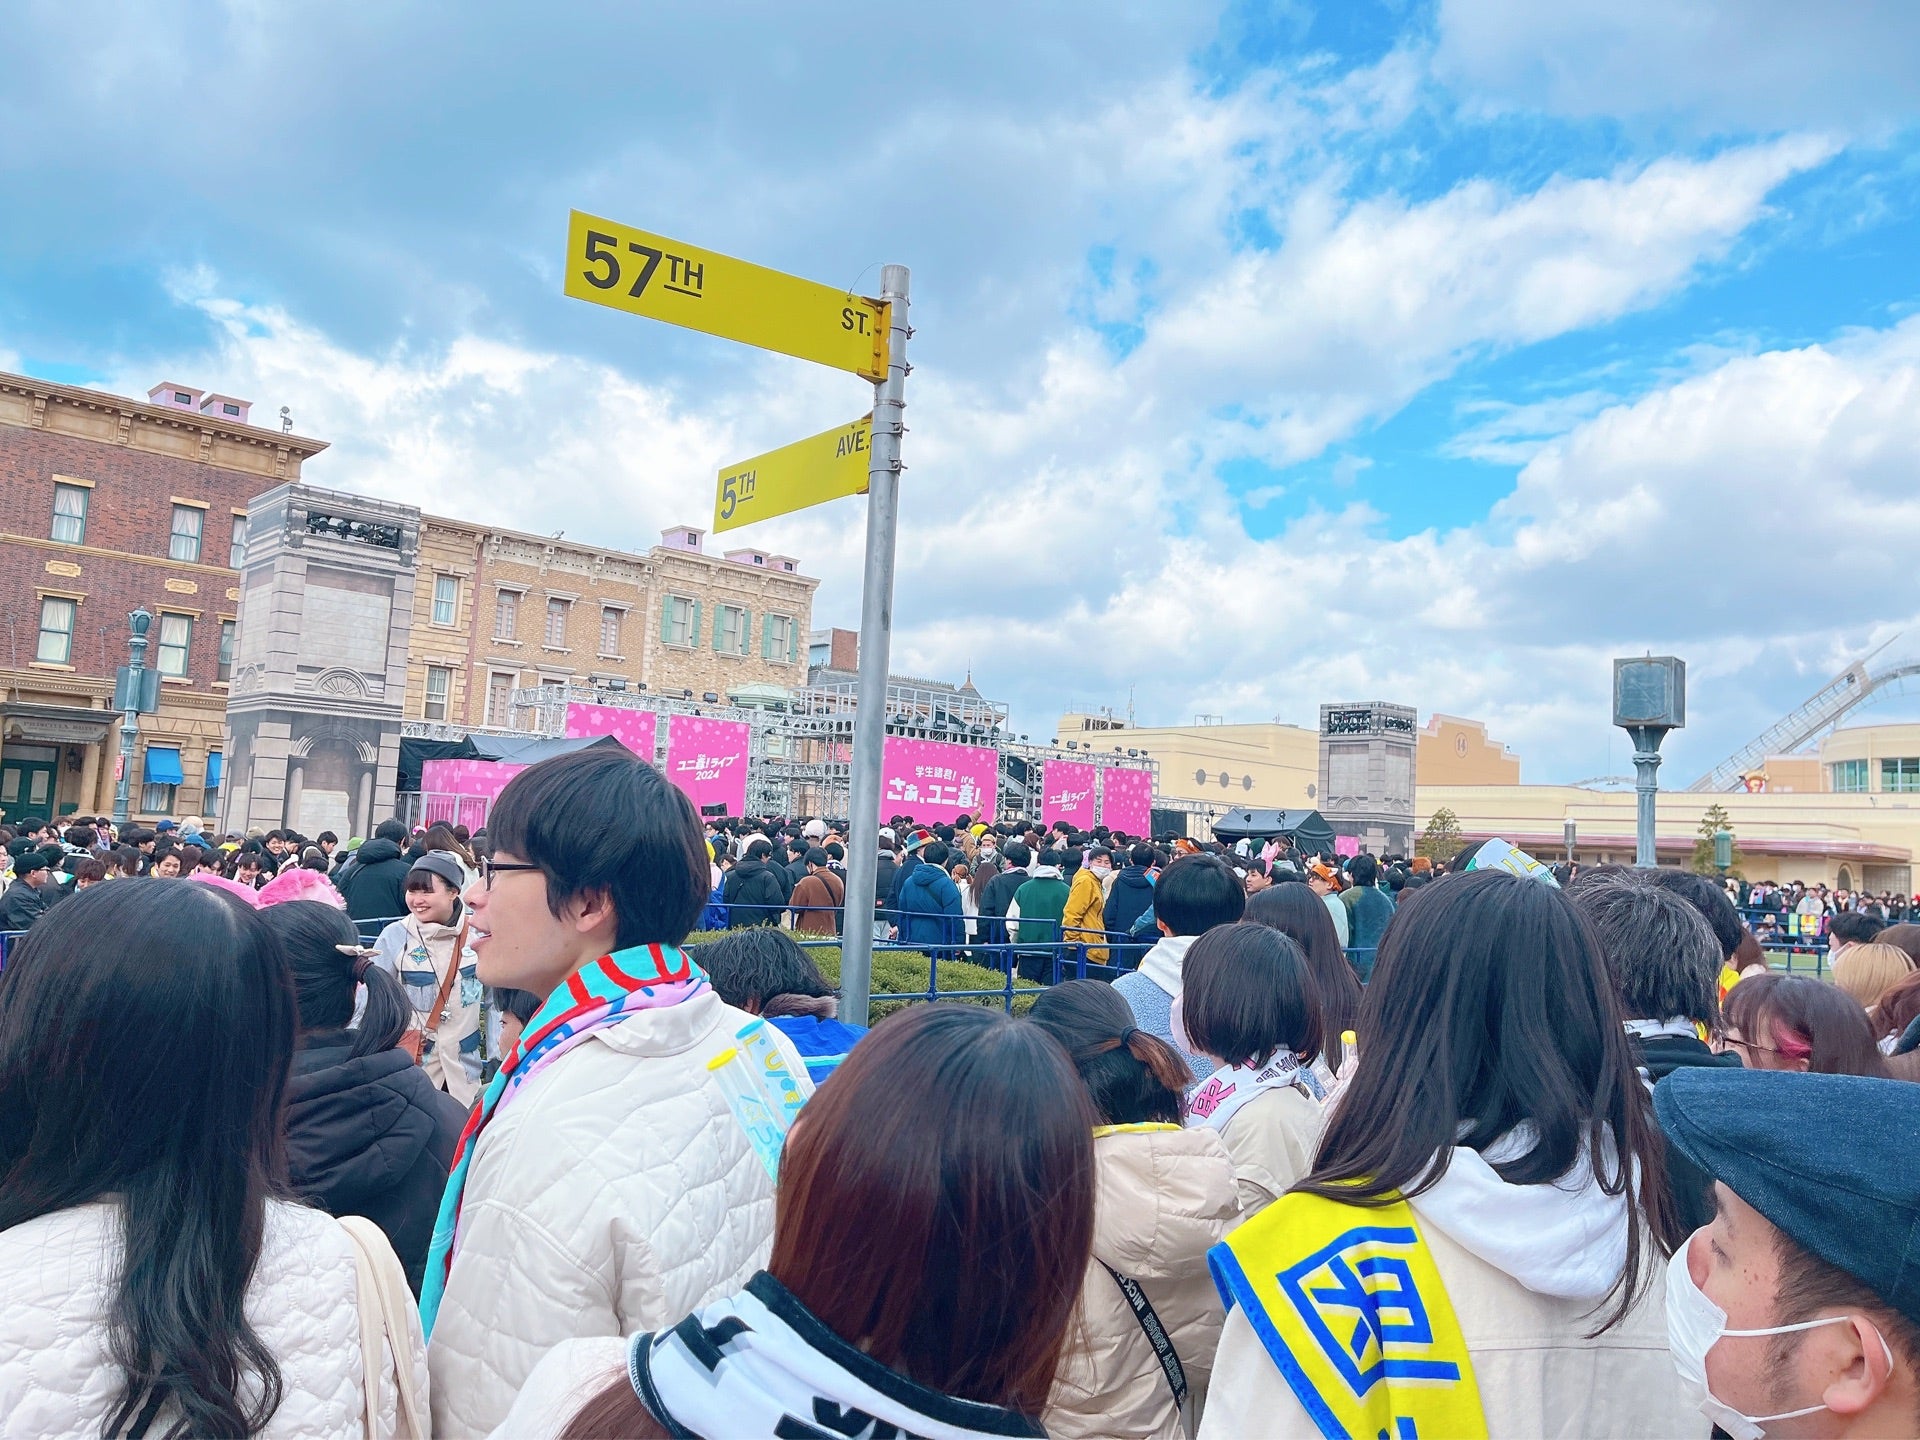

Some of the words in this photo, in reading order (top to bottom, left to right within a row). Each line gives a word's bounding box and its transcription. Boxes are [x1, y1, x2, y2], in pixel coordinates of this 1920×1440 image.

[582, 229, 704, 299] 57TH
[841, 307, 871, 336] ST.
[720, 470, 756, 520] 5TH
[836, 429, 870, 458] AVE.
[695, 769, 720, 781] 2024
[915, 765, 957, 781] 学生諸君!
[1060, 802, 1078, 811] 2024
[1116, 1271, 1146, 1312] MICKE
[1143, 1312, 1169, 1354] MOUSE
